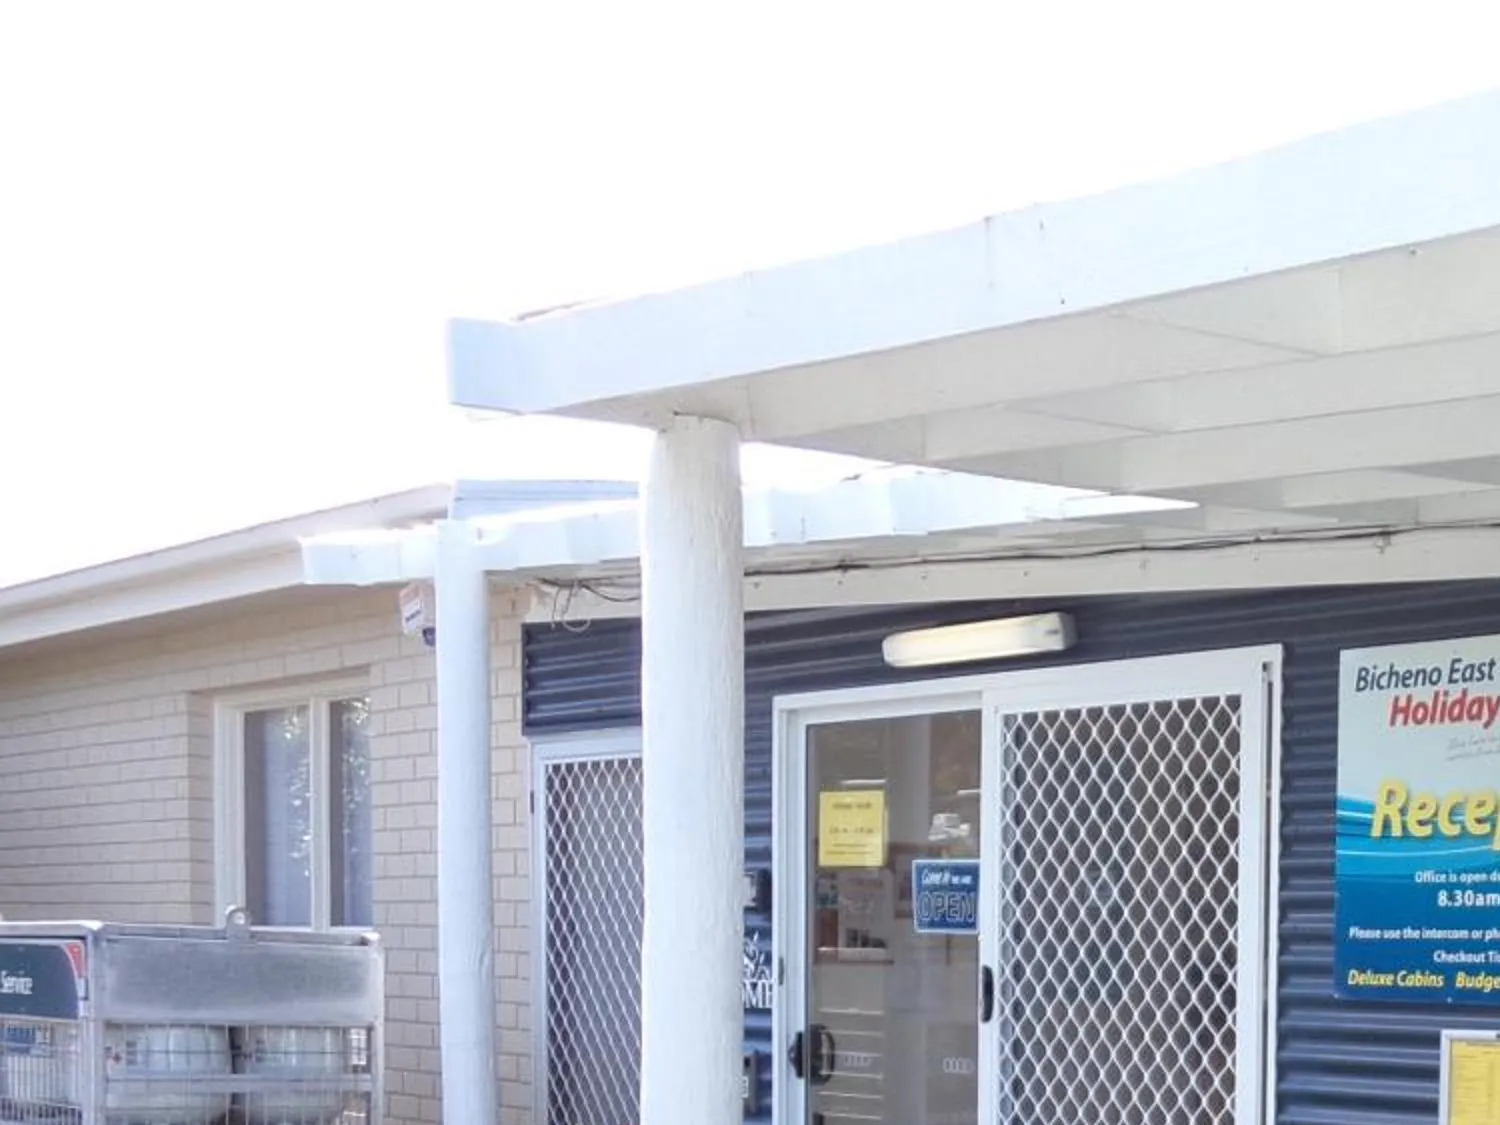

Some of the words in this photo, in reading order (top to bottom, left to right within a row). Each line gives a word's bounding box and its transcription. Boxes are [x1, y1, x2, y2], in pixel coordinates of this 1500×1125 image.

[1355, 663, 1441, 691] Bicheno
[1447, 656, 1497, 684] East
[1415, 870, 1446, 883] Office
[1449, 870, 1457, 883] is
[1459, 872, 1487, 885] open
[918, 892, 975, 922] OPEN
[1349, 925, 1381, 939] Please
[1383, 928, 1400, 939] use
[1403, 926, 1419, 939] the
[1422, 926, 1469, 939] intercom
[1471, 928, 1482, 939] or
[1433, 950, 1486, 963] Checkout
[0, 970, 33, 995] Service
[1347, 969, 1395, 986] Deluxe
[1397, 969, 1445, 987] Cabins
